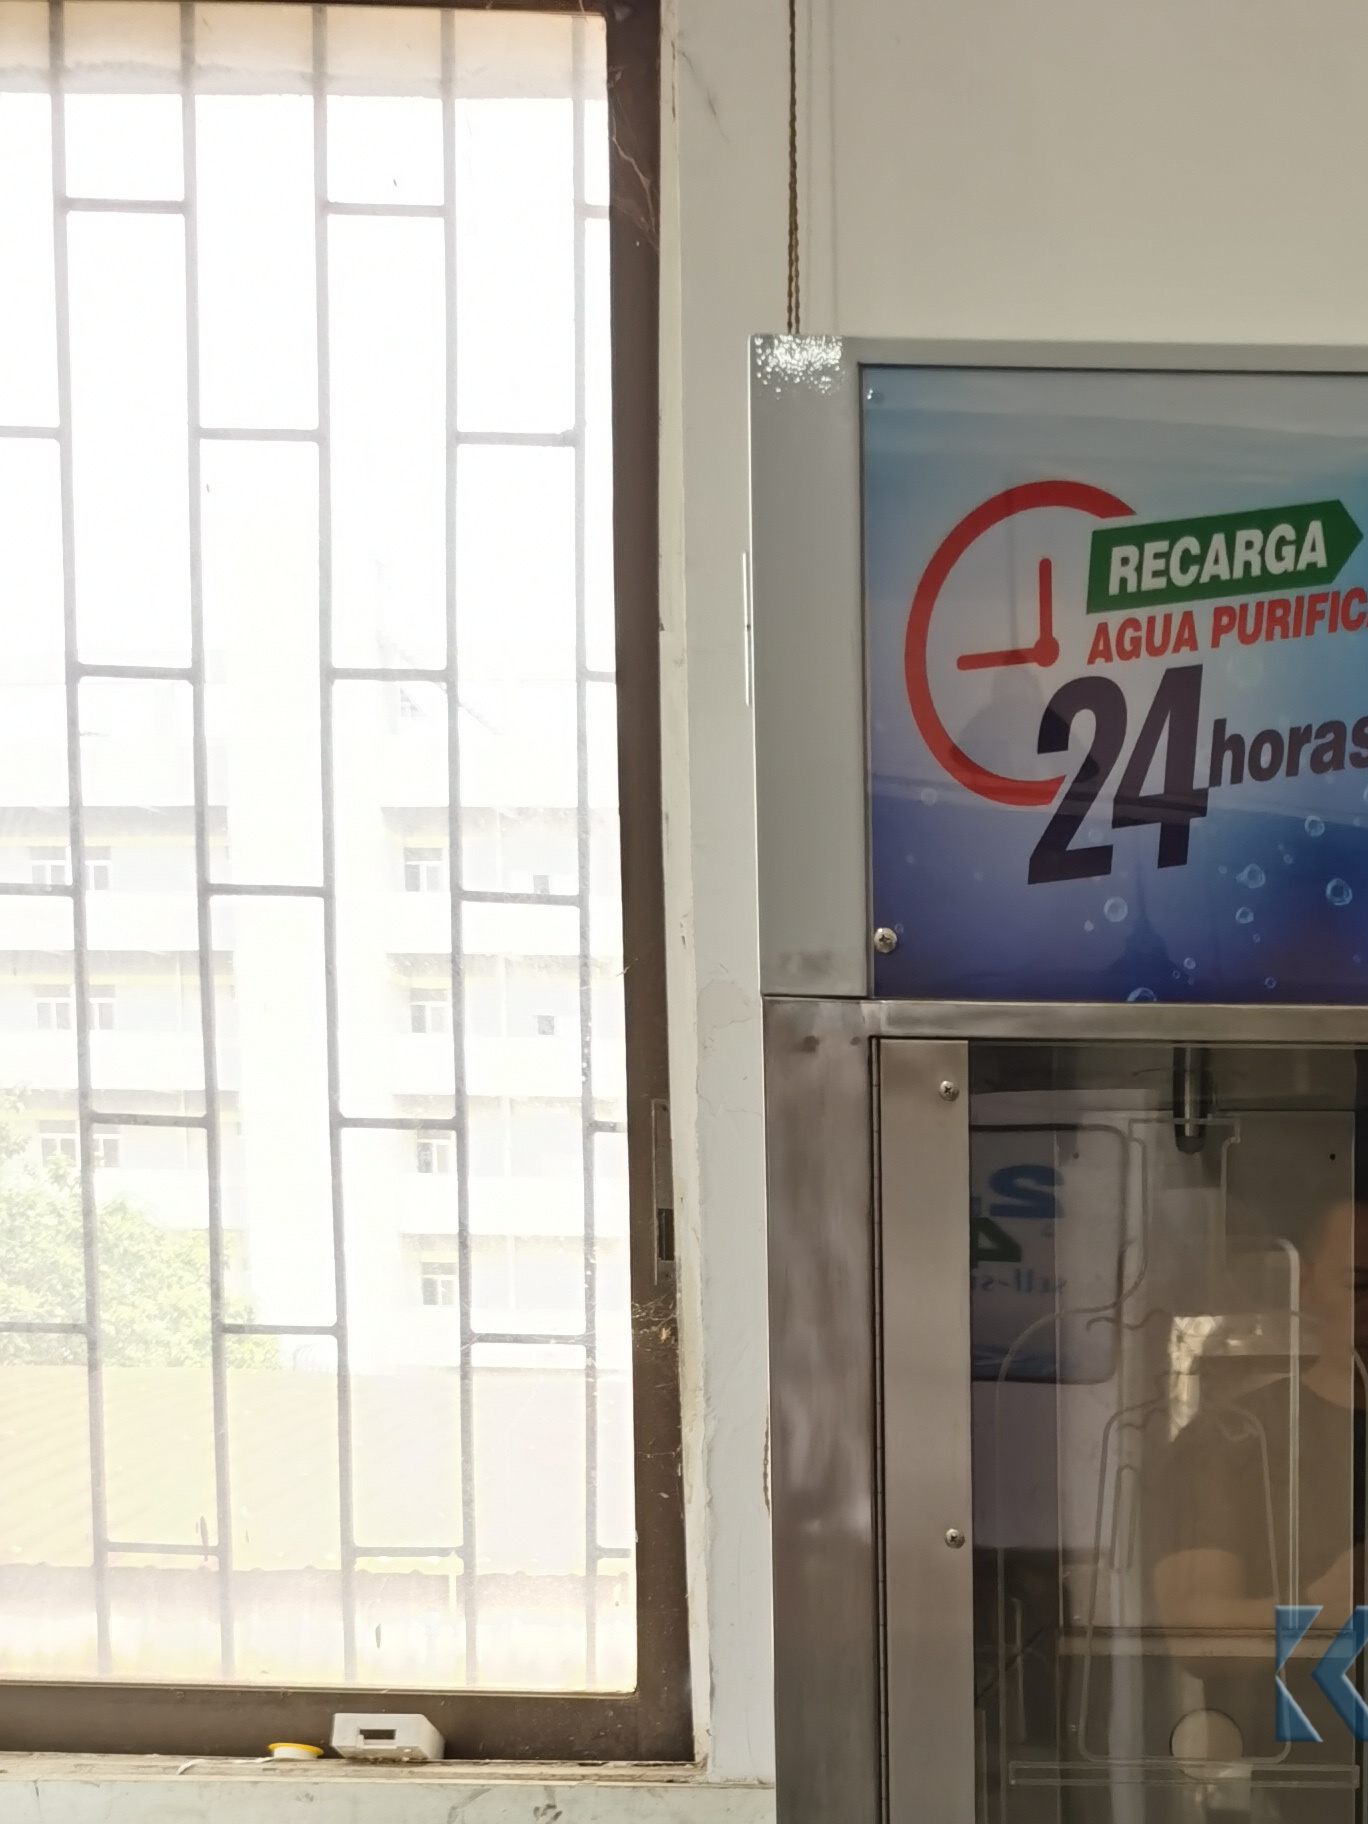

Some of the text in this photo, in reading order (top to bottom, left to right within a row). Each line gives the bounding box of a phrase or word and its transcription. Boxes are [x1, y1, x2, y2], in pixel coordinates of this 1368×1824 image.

[1109, 520, 1328, 595] RECARGA
[1087, 616, 1198, 664] AGUA
[1027, 664, 1209, 885] 24
